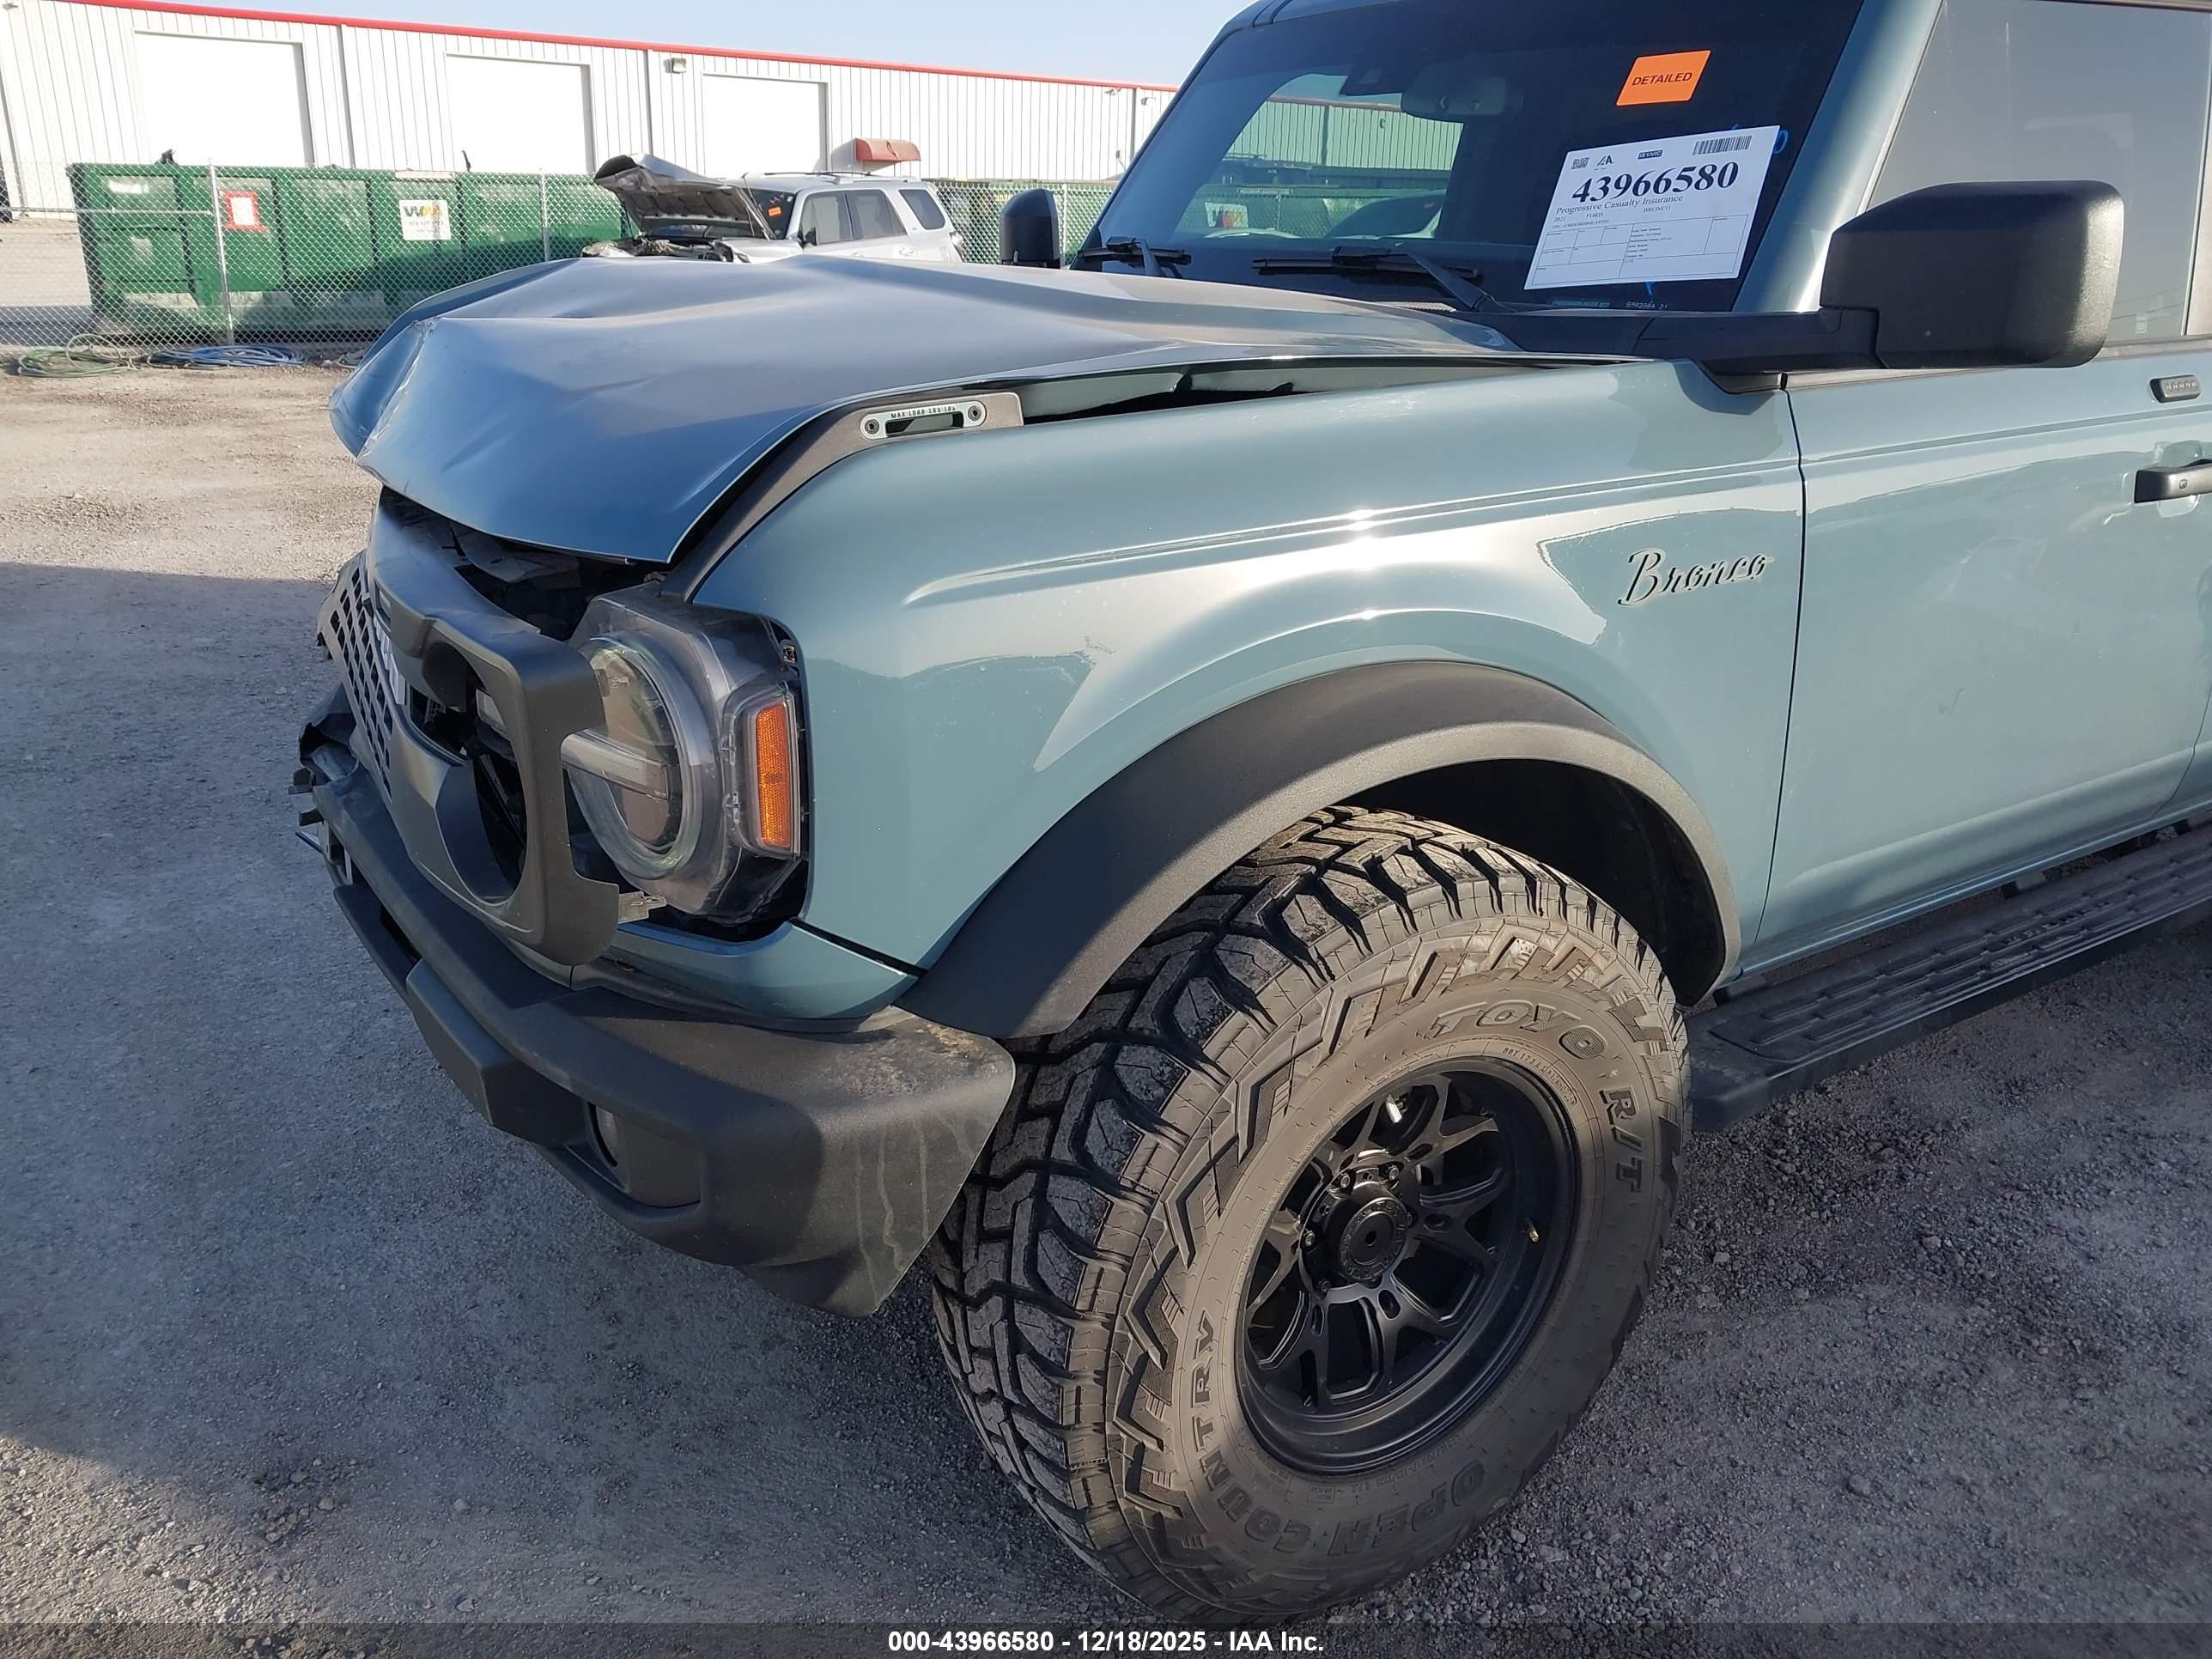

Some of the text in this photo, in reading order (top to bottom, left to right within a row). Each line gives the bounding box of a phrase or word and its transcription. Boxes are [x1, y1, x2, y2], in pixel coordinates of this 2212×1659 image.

[1632, 72, 1693, 86] DETAILED
[1556, 194, 1684, 215] Progressive Casualty Insurance
[1571, 161, 1739, 203] 43966580
[908, 408, 925, 417] LOAD
[1617, 548, 1775, 606] Bronco
[1430, 999, 1608, 1060] TOYO
[1599, 1085, 1644, 1194] R/T
[1191, 1310, 1313, 1554] COUNTRY
[1327, 1459, 1485, 1557] OPEN
